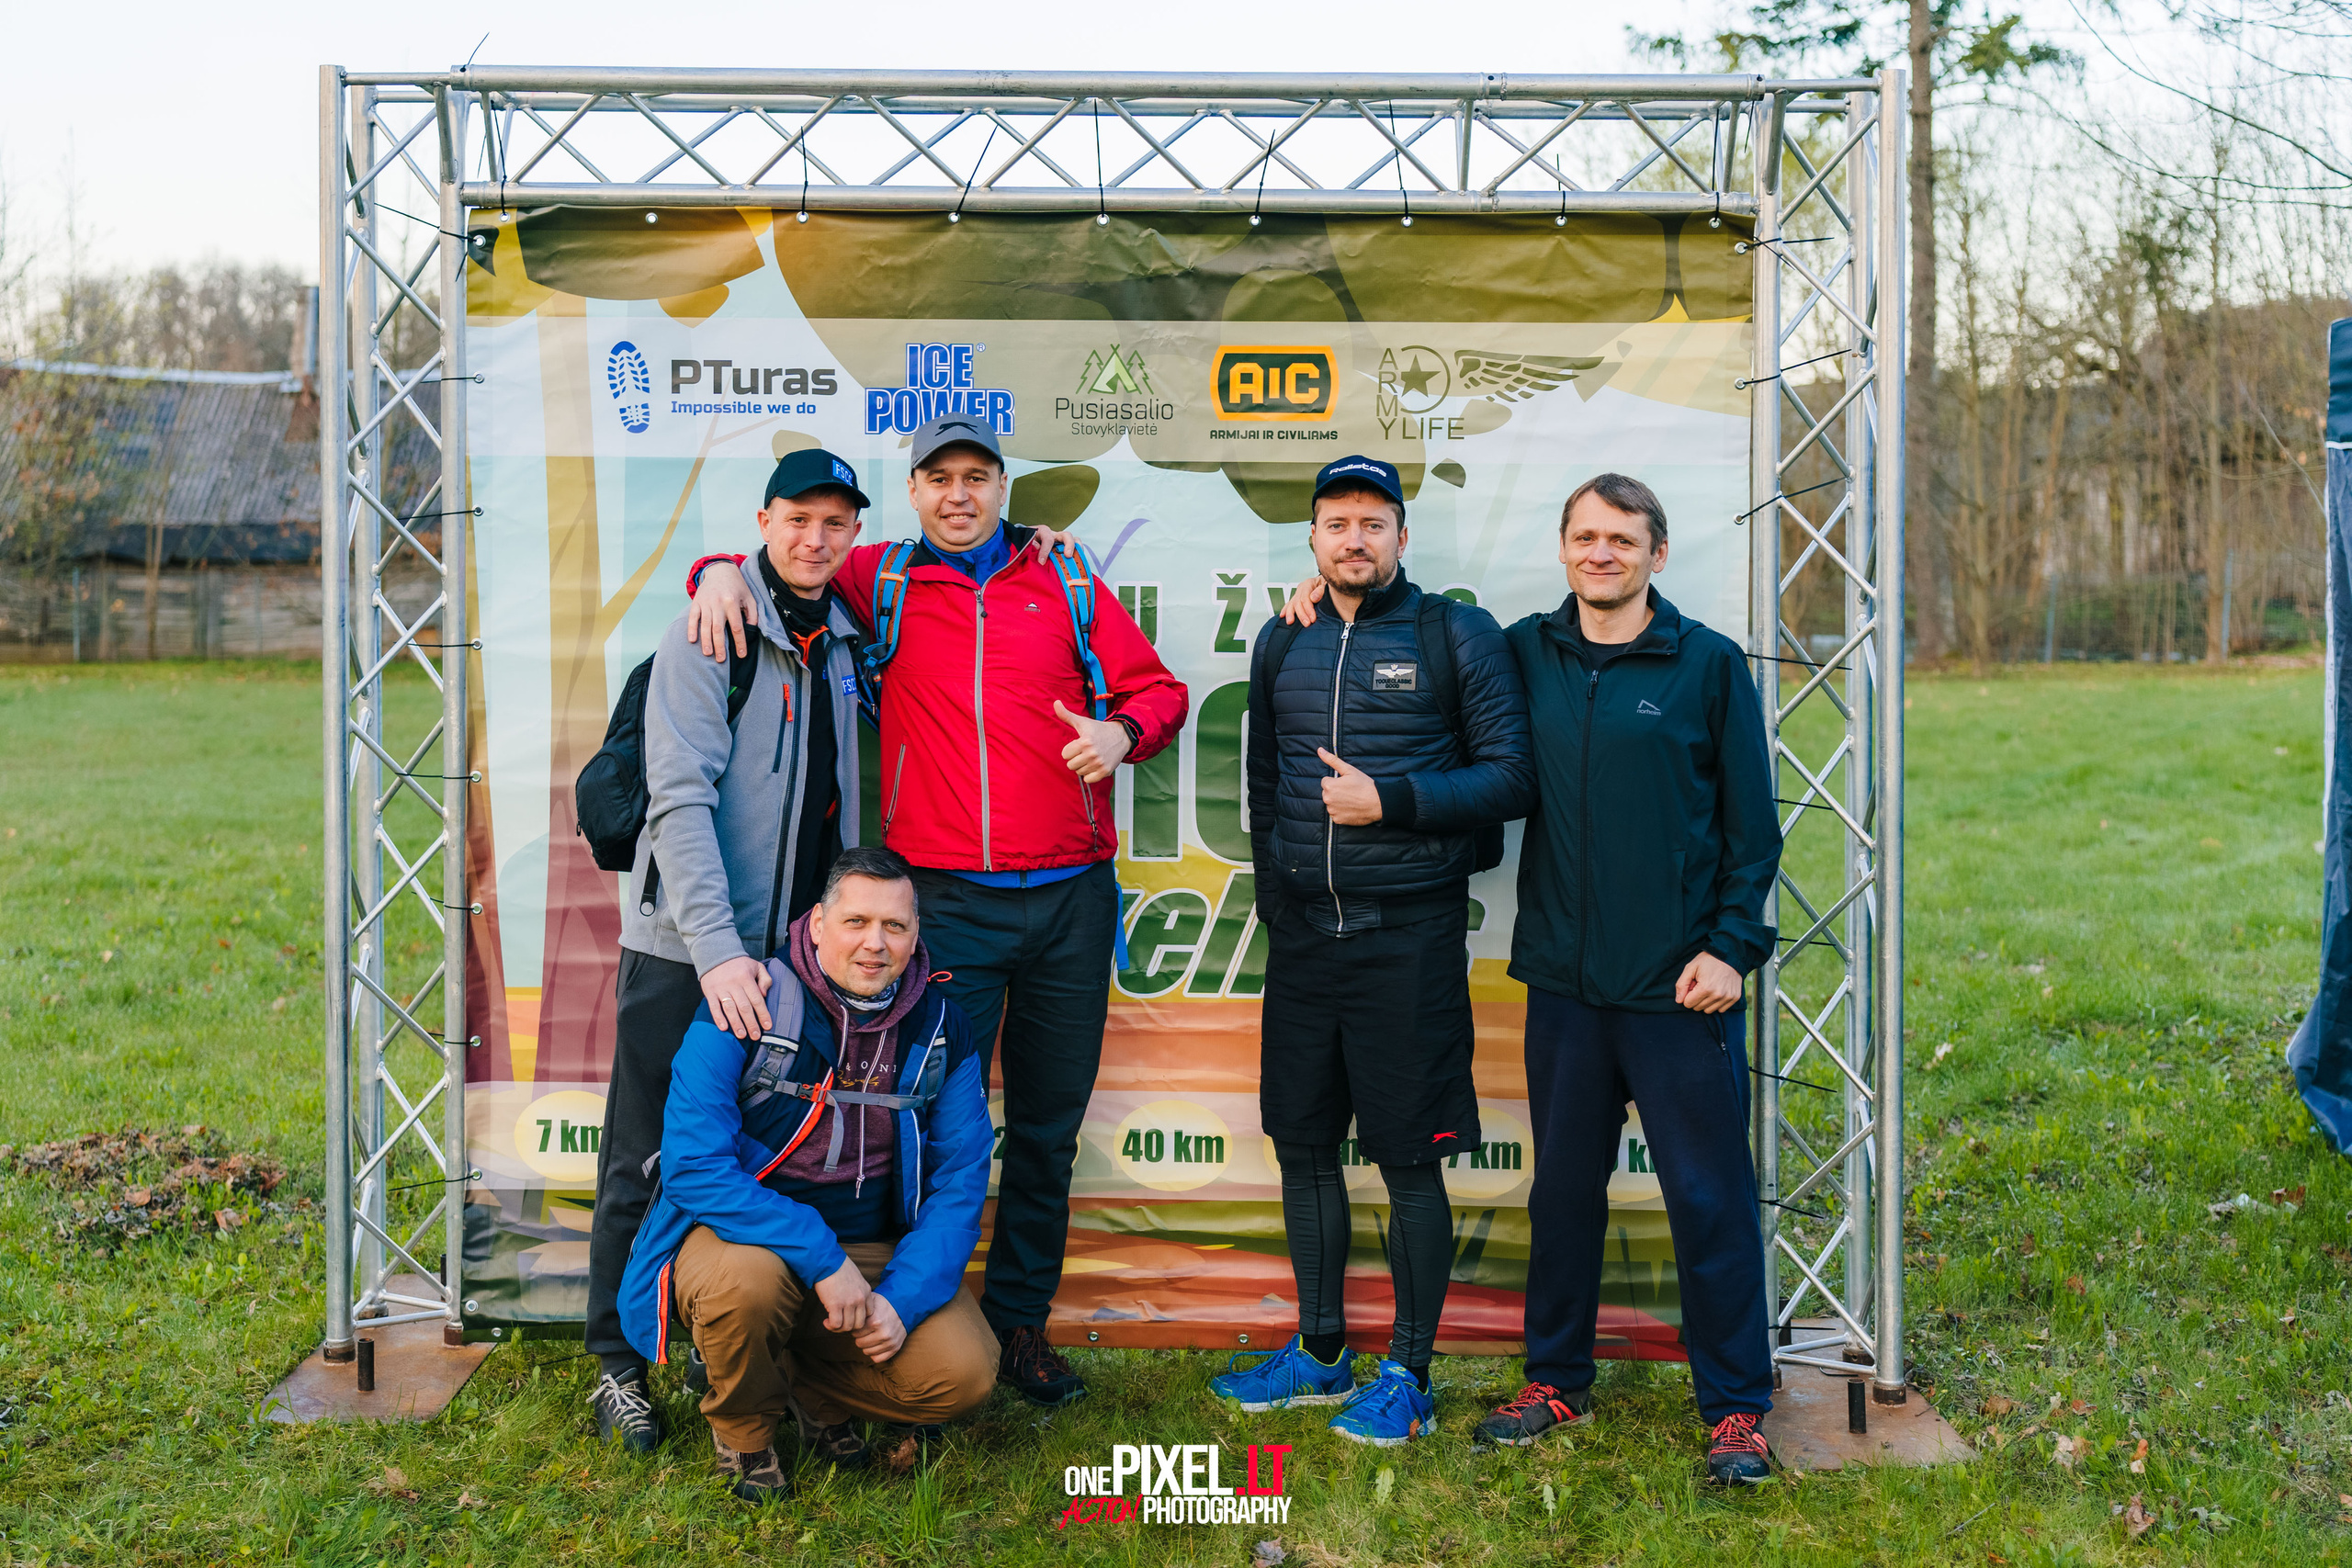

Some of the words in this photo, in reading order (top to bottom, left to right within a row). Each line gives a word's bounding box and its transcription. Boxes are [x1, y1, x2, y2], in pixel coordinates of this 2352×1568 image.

[671, 359, 838, 396] PTuras
[906, 343, 974, 389] ICE
[671, 400, 763, 416] Impossible
[767, 403, 791, 414] we
[796, 401, 817, 414] do
[1055, 397, 1174, 420] Pusiasalio
[1071, 422, 1158, 438] Stovyklavietė
[1209, 429, 1260, 440] ARMIJAI
[1262, 430, 1274, 440] IR
[1277, 430, 1339, 440] CIVILIAMS
[536, 1119, 553, 1153] 7
[1122, 1128, 1165, 1163] 40
[1173, 1129, 1225, 1164] km
